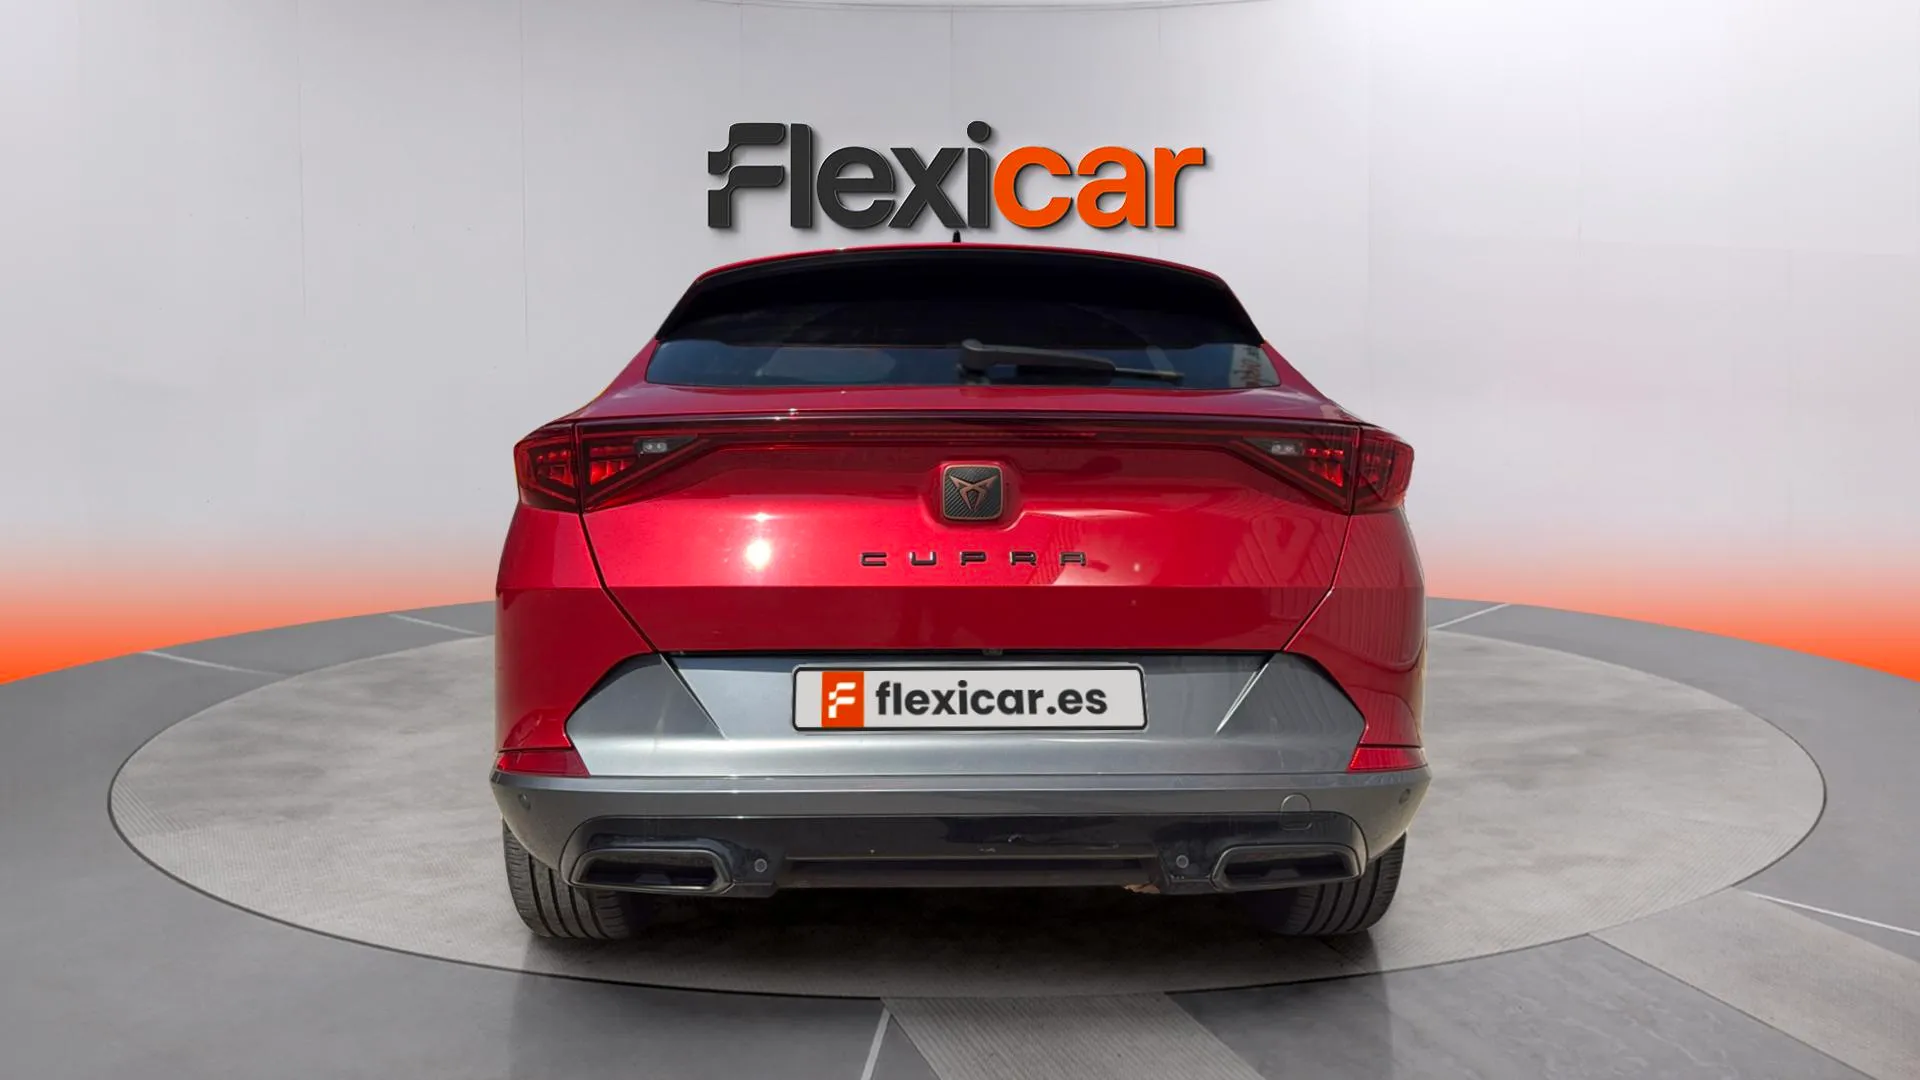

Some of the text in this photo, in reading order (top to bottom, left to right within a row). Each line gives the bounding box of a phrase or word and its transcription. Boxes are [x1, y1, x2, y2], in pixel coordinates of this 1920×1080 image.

[707, 120, 1206, 229] Flexicar
[860, 551, 1087, 567] CUPRA
[875, 680, 1108, 716] flexicar.es
